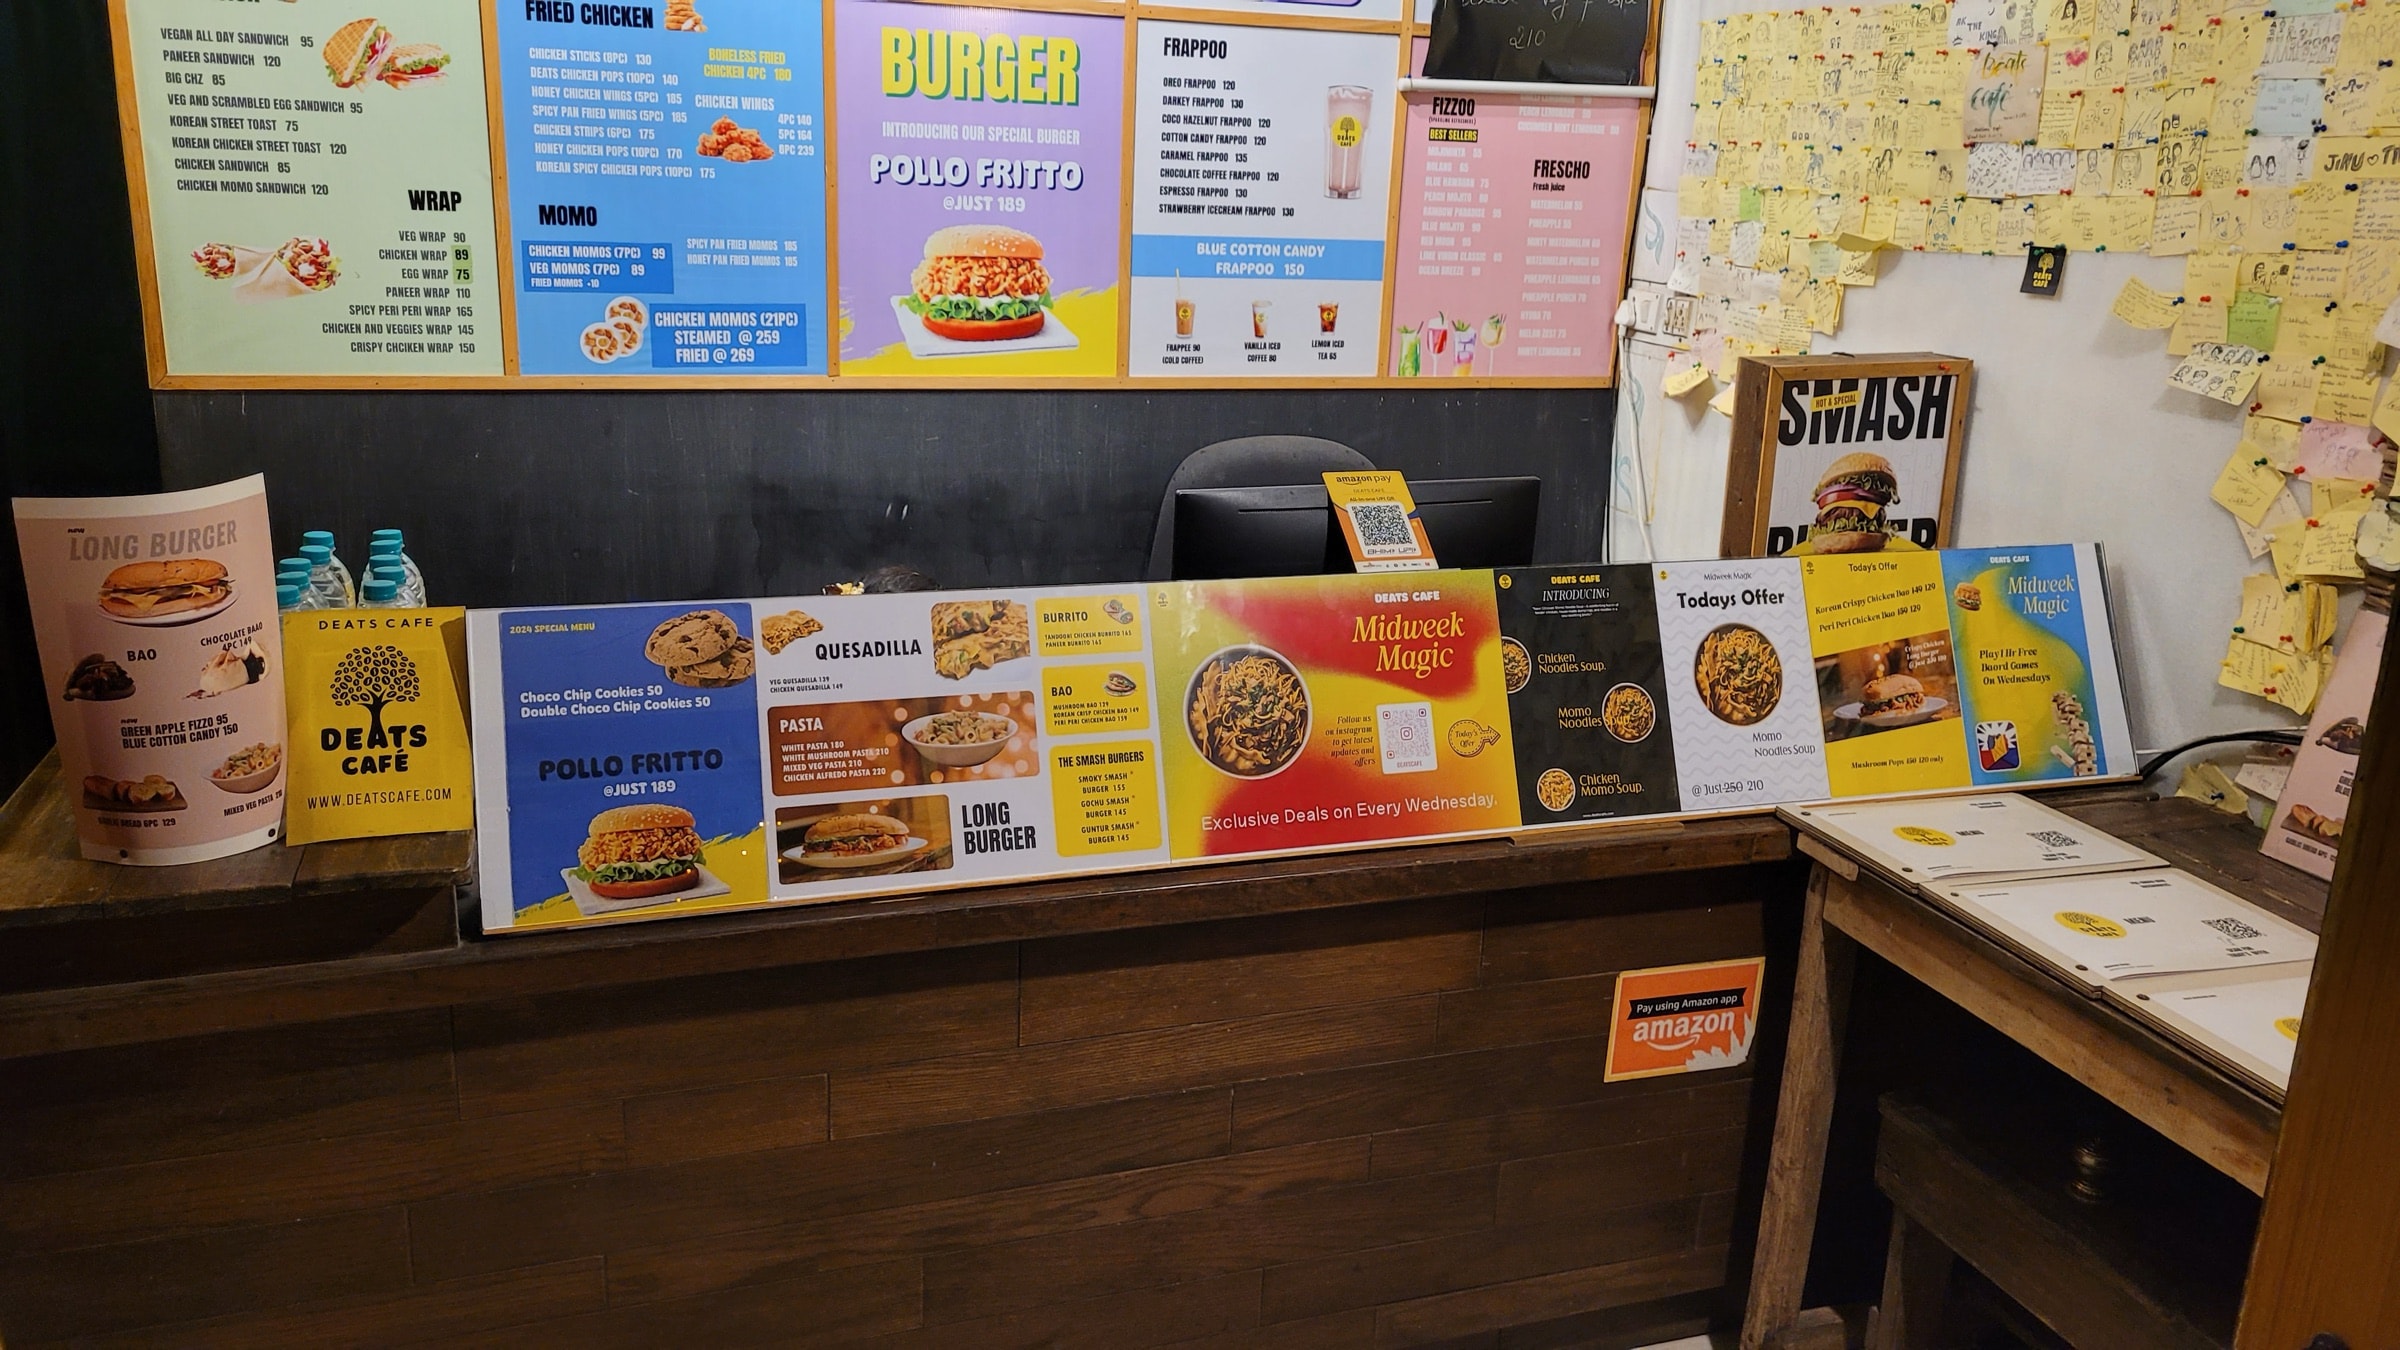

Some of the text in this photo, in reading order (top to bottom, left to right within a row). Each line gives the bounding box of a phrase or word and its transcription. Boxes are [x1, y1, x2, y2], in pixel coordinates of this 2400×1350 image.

[525, 0, 654, 29] FRIED CHICKEN
[161, 27, 314, 47] VEGAN ALL DAY SANDWICH 95
[1509, 26, 1546, 49] 210
[1163, 37, 1227, 59] FRAPPOO
[881, 25, 1080, 106] BURGER
[165, 72, 225, 86] BIG CHZ 85
[167, 93, 363, 114] VEG AND SCRAMBLED EGG SANDWICH 95
[695, 94, 774, 111] CHICKEN WINGS
[1432, 97, 1475, 117] FIZZOO
[778, 113, 812, 126] 4PC 140
[882, 121, 1080, 145] INTRODUCING OUR SPECIAL BURGER
[1429, 129, 1478, 142] BEST SELLERS
[870, 154, 1084, 191] POLLO FRITTO
[1533, 160, 1590, 179] FRESCHO
[1160, 186, 1247, 198] ESPRESSO FRAPPOO 130
[1533, 182, 1549, 191] Fresh
[408, 189, 461, 211] WRAP
[943, 196, 1025, 212] @JUST 189
[539, 204, 597, 227] MOMO
[379, 249, 468, 261] CHICKEN WRAP 89
[529, 245, 665, 259] CHICKEN MOMOS (7PC) 99
[1196, 243, 1325, 258] BLUE COTTON CANDY
[1215, 262, 1304, 276] FRAPPOO 150
[349, 305, 473, 317] SPICY PERI PERI WRAP 165
[655, 312, 798, 327] CHICKEN MOMOS (21PC)
[675, 330, 779, 345] STEAMED @ 259
[676, 348, 754, 363] FRIED @ 269
[1816, 398, 1826, 407] HOT
[1834, 395, 1856, 405] SPECIAL
[1778, 375, 1953, 446] SMASH
[1336, 475, 1391, 483] amazon pay
[70, 520, 238, 561] LONG BURGER
[1849, 562, 1898, 573] Today's Offer
[1551, 575, 1600, 584] DEATS CAFE
[2008, 574, 2075, 595] Midweek
[1374, 590, 1440, 603] DEATS CAFE
[1542, 588, 1610, 602] INTRODUCING
[1676, 589, 1784, 610] Todays Offer
[2023, 597, 2069, 619] Magic
[319, 618, 433, 630] DEATS CAFE
[1043, 611, 1088, 623] BURRITO
[510, 622, 595, 634] 2024 SPECIAL MENU
[1352, 611, 1465, 643] Midweek
[200, 629, 245, 647] CHOCOLATE
[127, 649, 157, 662] BAO
[815, 639, 922, 661] QUESADILLA
[1537, 653, 1575, 664] Chicken
[1376, 641, 1454, 679] Magic
[1539, 662, 1579, 674] Noodles
[1983, 674, 2051, 685] On Wednesdays
[520, 685, 663, 703] Choco Chip Cookies 50
[1051, 686, 1072, 696] BAO
[121, 713, 229, 737] GREEN APPLE FIZZO 95
[780, 717, 823, 733] PASTA
[321, 725, 427, 751] DEATS
[1752, 732, 1782, 742] Momo
[1058, 751, 1144, 768] THE SMASH BURGERS
[1754, 745, 1816, 757] Noodles Soup
[342, 749, 408, 775] CAFÉ
[539, 749, 723, 782] POLLO FRITTO
[783, 767, 886, 782] CHICKEN ALFREDO PASTA 220
[603, 780, 676, 797] @JUST 189
[1692, 785, 1701, 797] @
[1704, 783, 1723, 795] Just
[1747, 780, 1763, 791] 210
[308, 788, 451, 809] WWW.DEATSCAFE.COM
[962, 801, 1010, 828] LONG
[1201, 791, 1498, 831] Exclusive Deals on Every Wednesday.
[964, 825, 1036, 855] BURGER
[1637, 995, 1737, 1014] Pay using Amazon app
[1633, 1011, 1735, 1042] amazon
